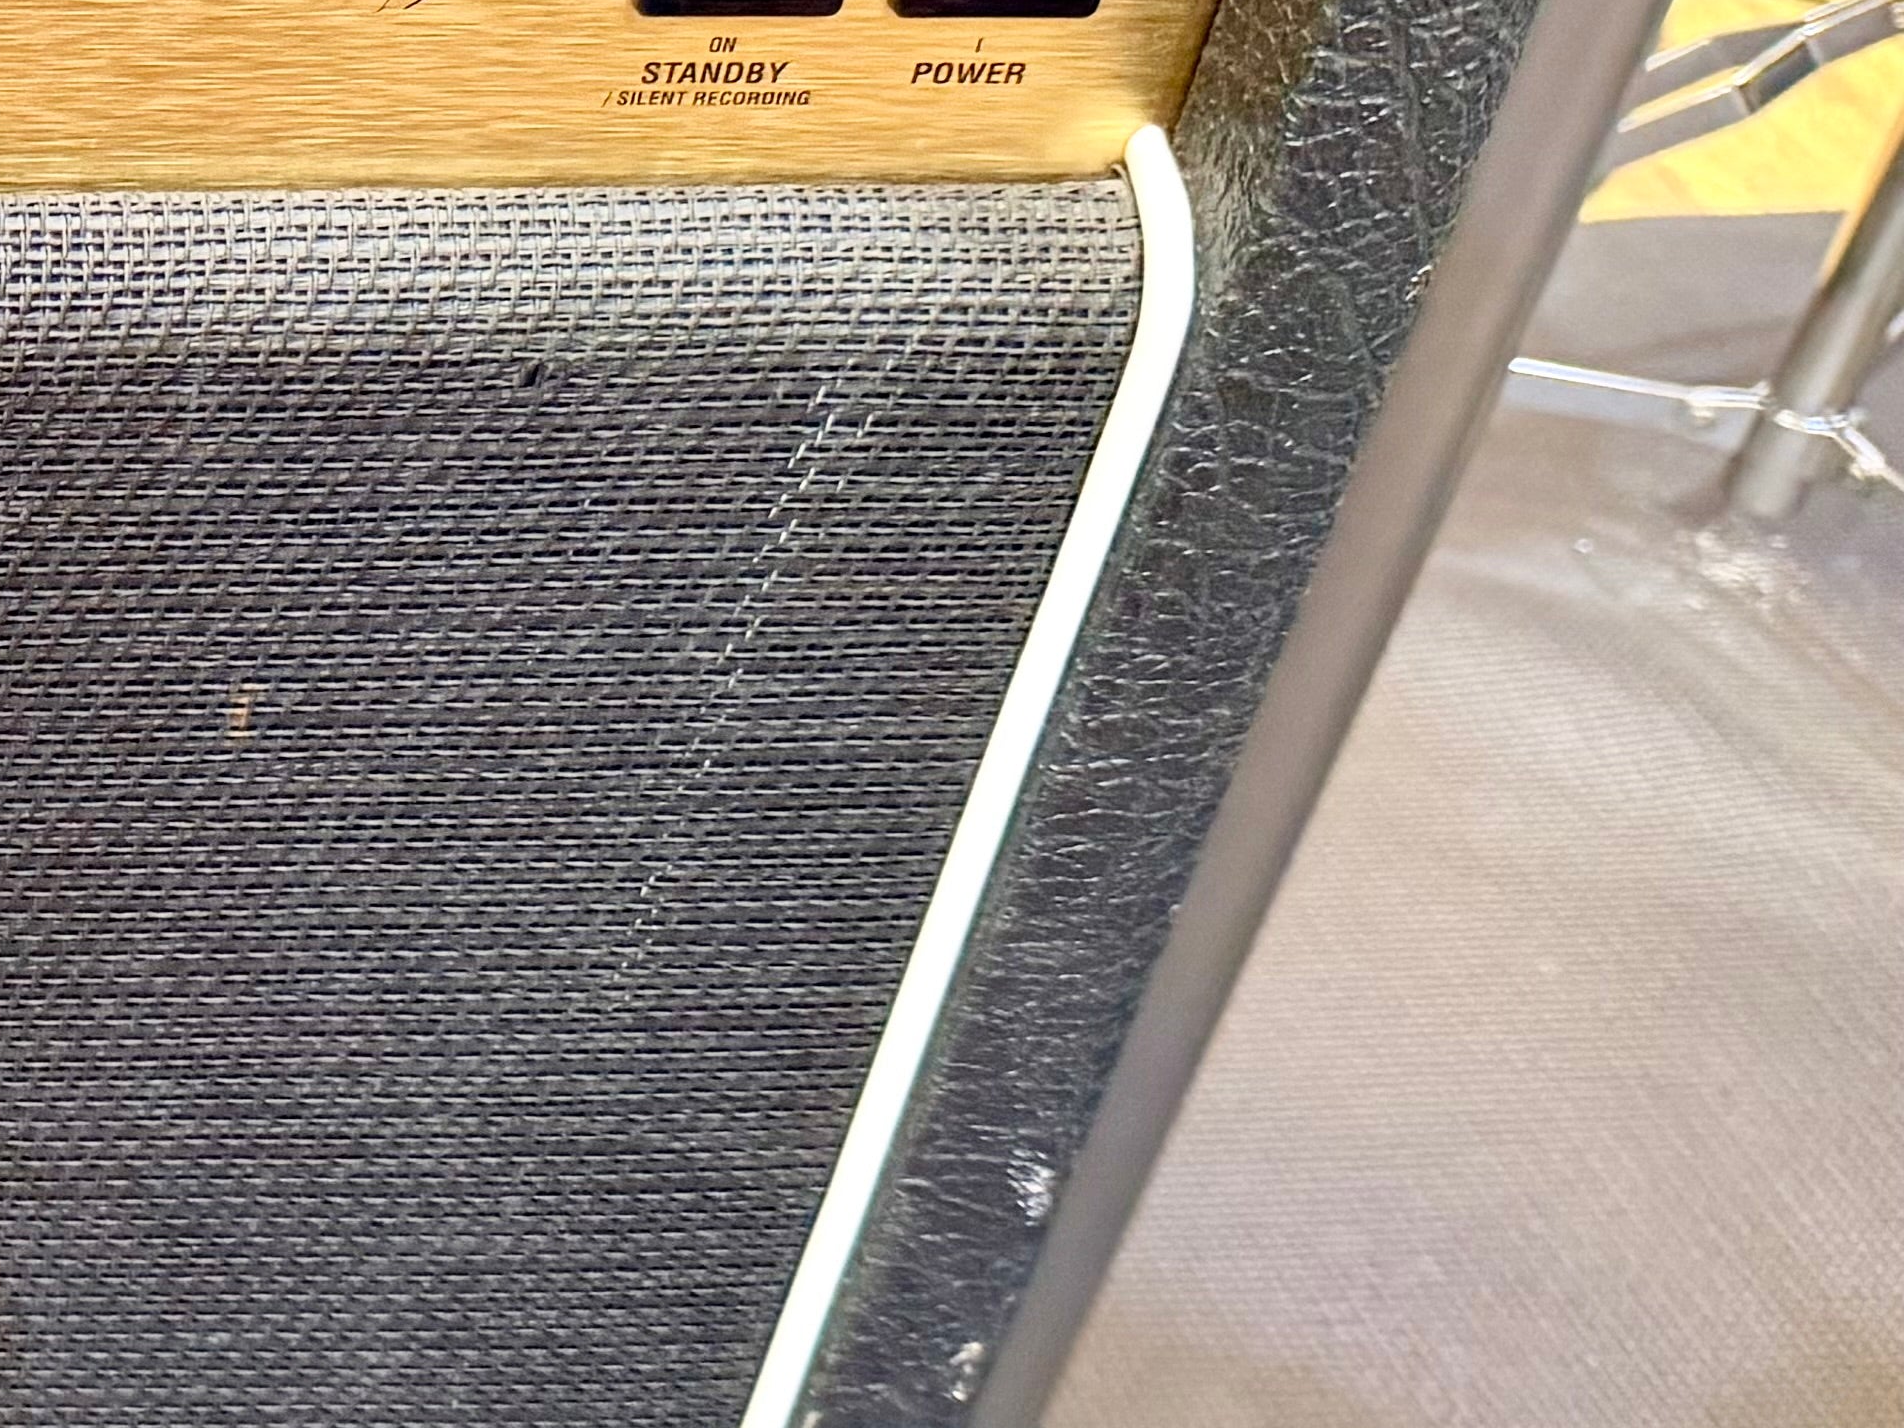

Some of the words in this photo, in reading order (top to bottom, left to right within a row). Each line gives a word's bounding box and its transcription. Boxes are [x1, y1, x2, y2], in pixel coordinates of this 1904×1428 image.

[709, 37, 737, 53] ON
[641, 61, 789, 85] STANDBY
[911, 61, 1027, 85] POWER
[617, 90, 688, 106] SILENT
[692, 90, 811, 106] RECORDING
